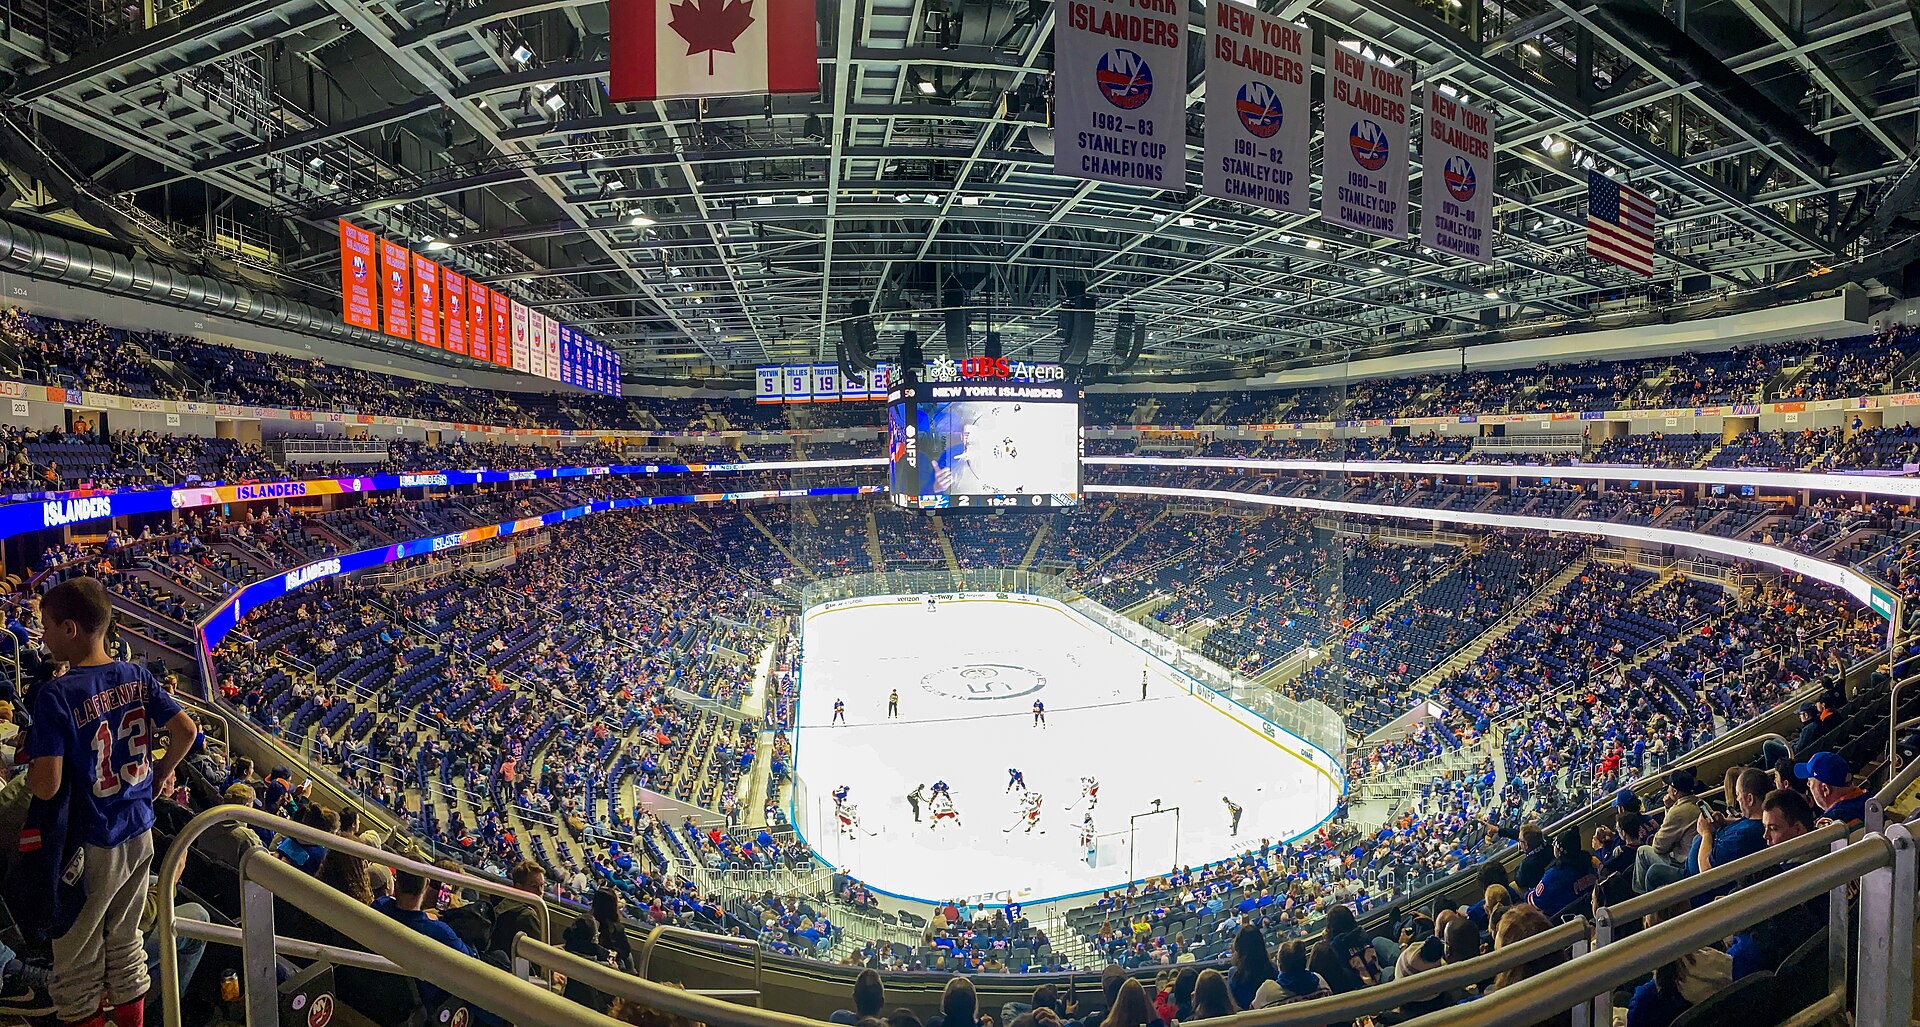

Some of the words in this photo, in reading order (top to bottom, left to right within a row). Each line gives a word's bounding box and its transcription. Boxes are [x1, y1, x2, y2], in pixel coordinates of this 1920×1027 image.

[1068, 0, 1179, 49] ISLANDERS
[1217, 2, 1254, 38] NEW
[1261, 20, 1303, 55] YORK
[1215, 34, 1304, 85] ISLANDERS
[1334, 48, 1365, 82] NEW
[1369, 65, 1403, 98] YORK
[1333, 77, 1405, 125] ISLANDERS
[1431, 91, 1456, 122] NEW
[1460, 107, 1488, 136] YORK
[1078, 131, 1138, 157] STANLEY
[1142, 141, 1166, 160] CUP
[1430, 117, 1488, 160] ISLANDERS
[1081, 155, 1163, 181] CHAMPIONS
[1222, 157, 1271, 182] STANLEY
[1272, 168, 1293, 186] CUP
[1225, 178, 1290, 206] CHAMPIONS
[1338, 185, 1379, 210] STANLEY
[1379, 197, 1397, 215] CUP
[1340, 204, 1394, 232] CHAMPIONS
[1435, 216, 1467, 237] STANLEY
[1467, 224, 1482, 241] CUP
[1436, 232, 1480, 257] CHAMPIONS
[13, 287, 28, 296] 304
[786, 369, 808, 377] GILLIES
[814, 368, 838, 376] TROTTIER
[961, 356, 1010, 377] UBS
[1014, 361, 1065, 379] Arena
[764, 378, 773, 392] 5
[793, 377, 802, 391] 9
[819, 376, 834, 391] 19
[932, 387, 961, 398] NEW
[964, 386, 997, 398] YORK
[998, 386, 1064, 399] ISLANDERS
[14, 403, 26, 413] 203
[237, 482, 306, 500] ISLANDERS
[958, 495, 970, 507] 2
[1031, 495, 1043, 507] 0
[43, 495, 111, 527] ISLANDERS
[285, 558, 341, 592] ISLANDERS
[91, 705, 150, 798] 13
[1011, 910, 1018, 919] 5
